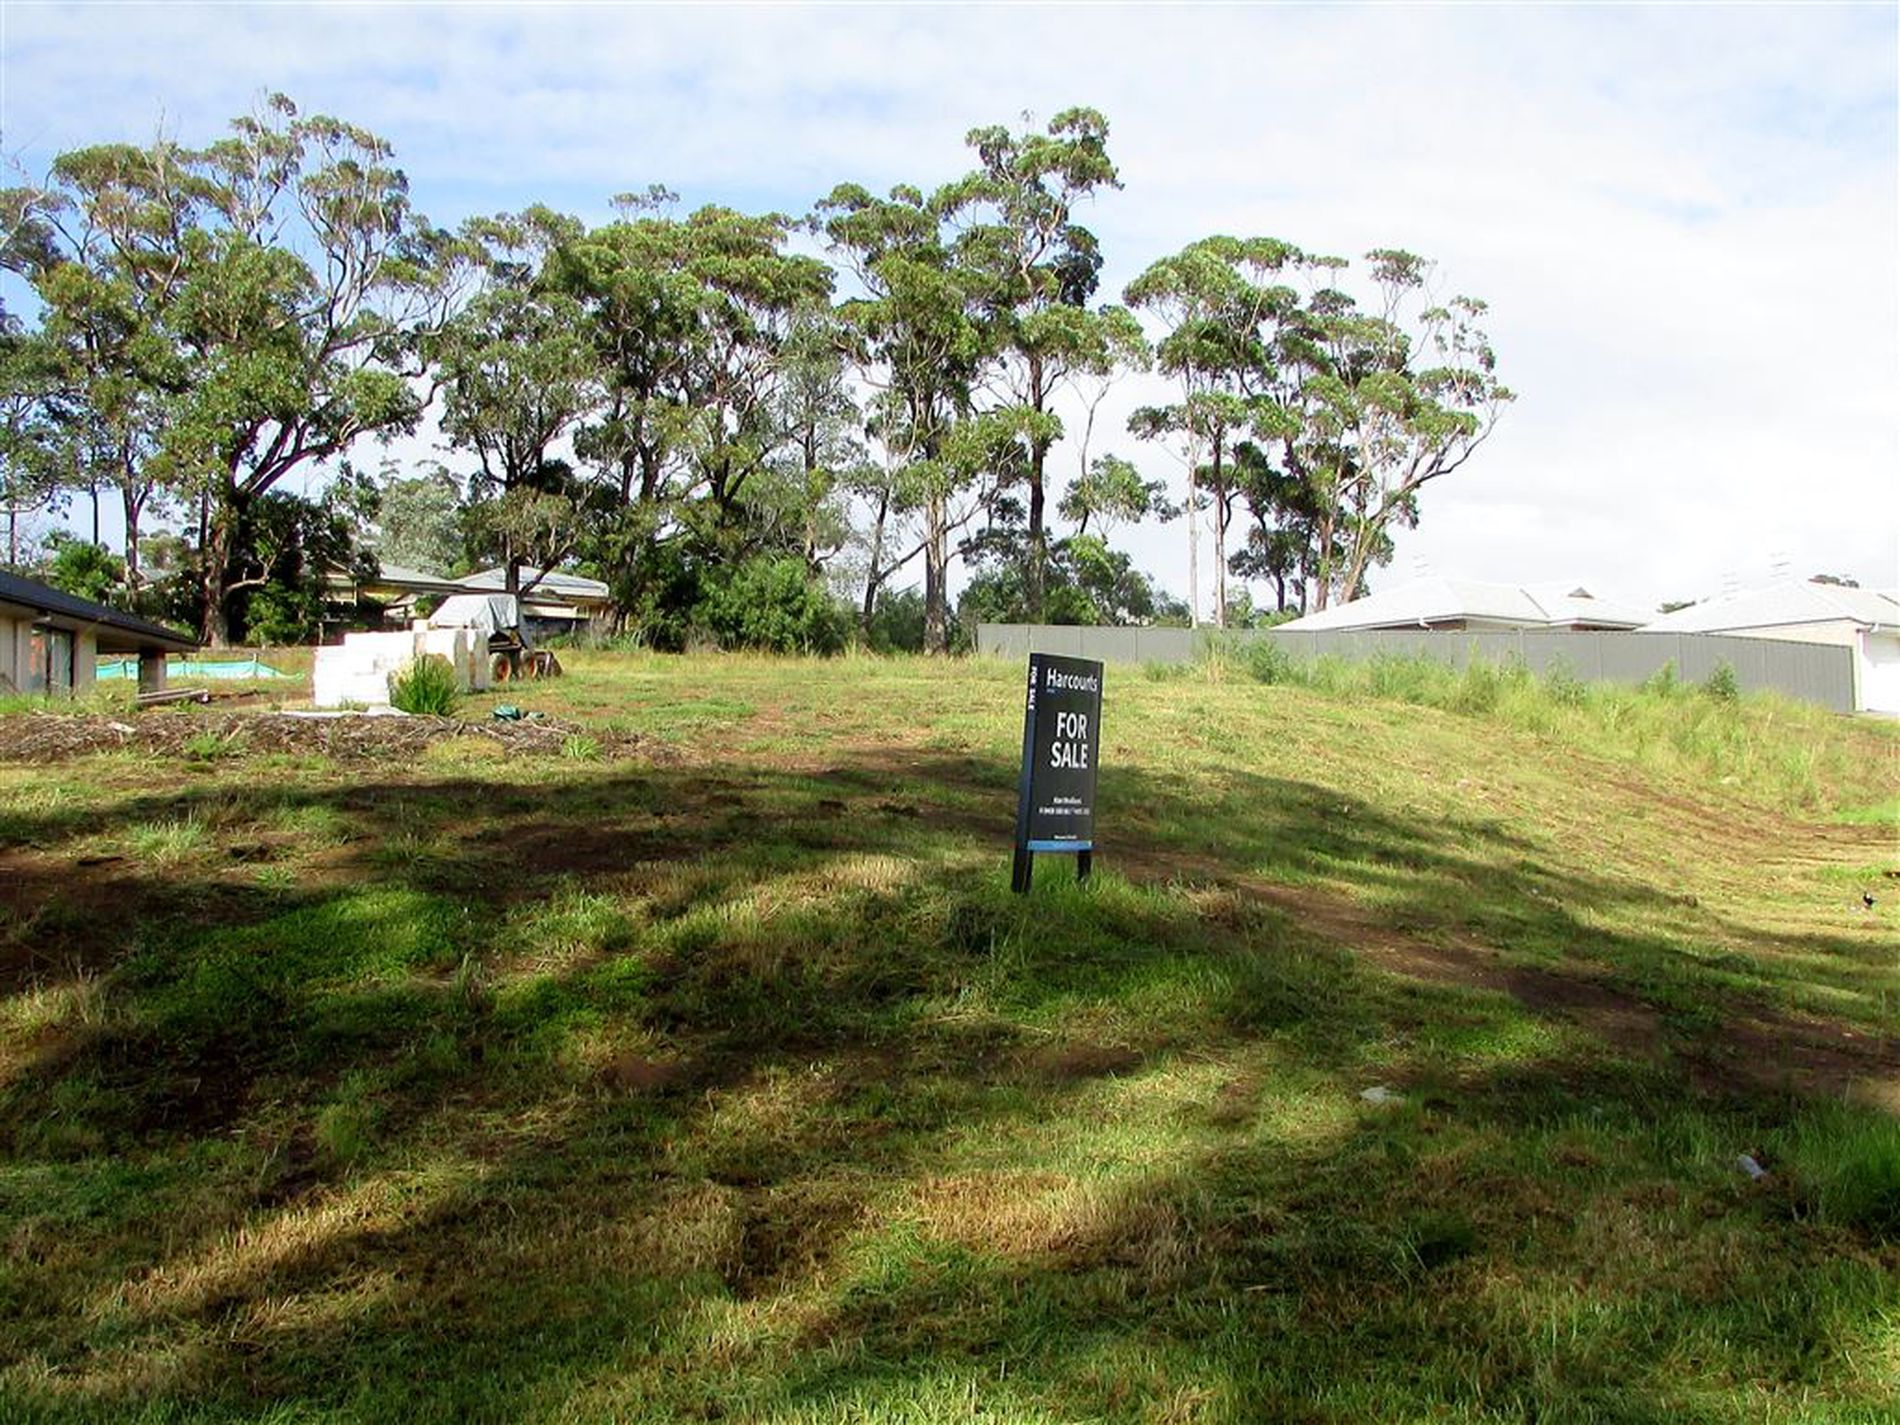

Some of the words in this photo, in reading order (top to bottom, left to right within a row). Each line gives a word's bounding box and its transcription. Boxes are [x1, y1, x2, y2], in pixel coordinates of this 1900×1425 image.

[1047, 667, 1098, 692] Harcourts
[1057, 712, 1088, 739] FOR
[1050, 741, 1089, 769] SALE
